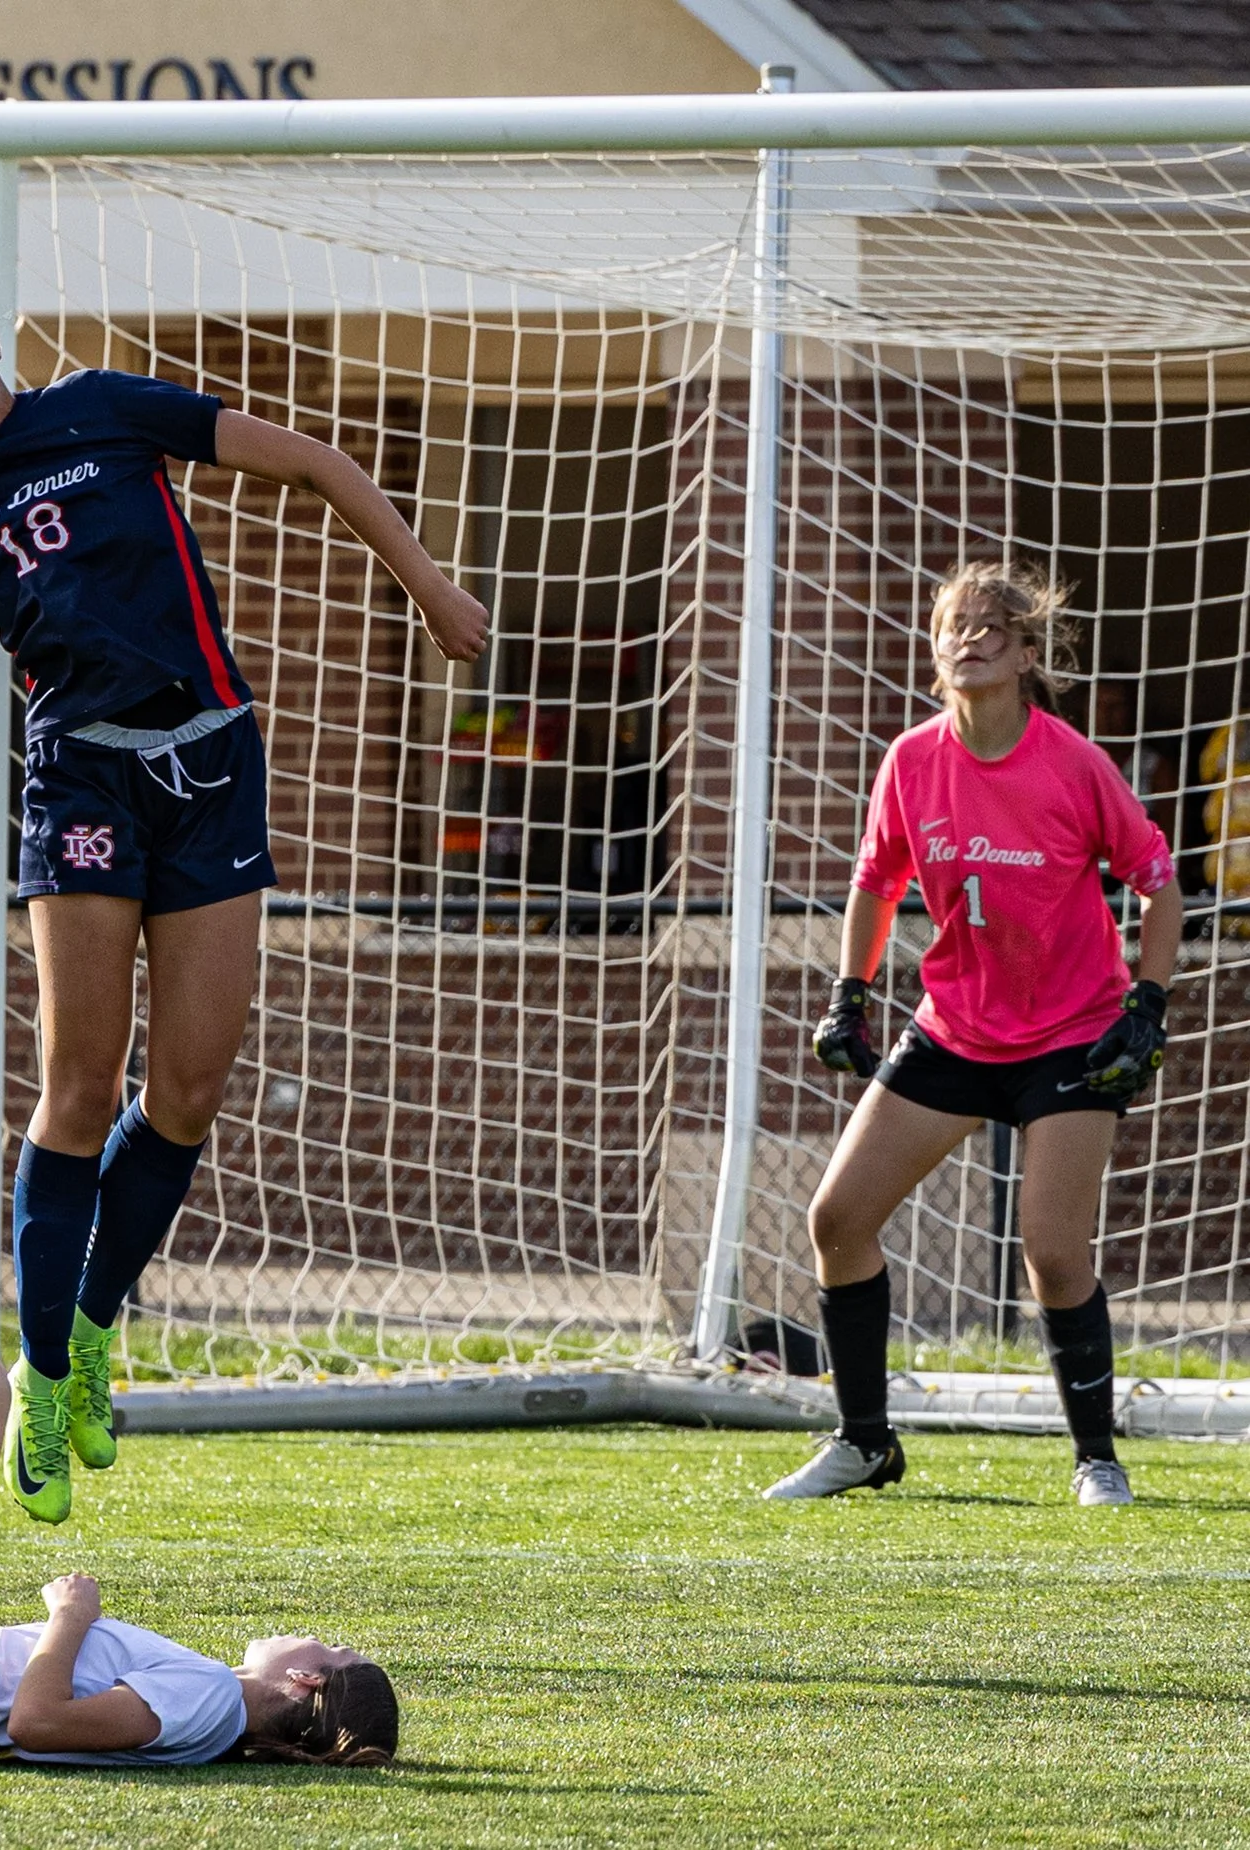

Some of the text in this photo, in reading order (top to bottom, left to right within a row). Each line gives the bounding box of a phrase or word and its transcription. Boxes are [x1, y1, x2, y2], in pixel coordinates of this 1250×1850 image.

[7, 462, 100, 509] Denver
[0, 500, 70, 579] 18
[962, 836, 1045, 867] Denver
[961, 872, 987, 928] 1
